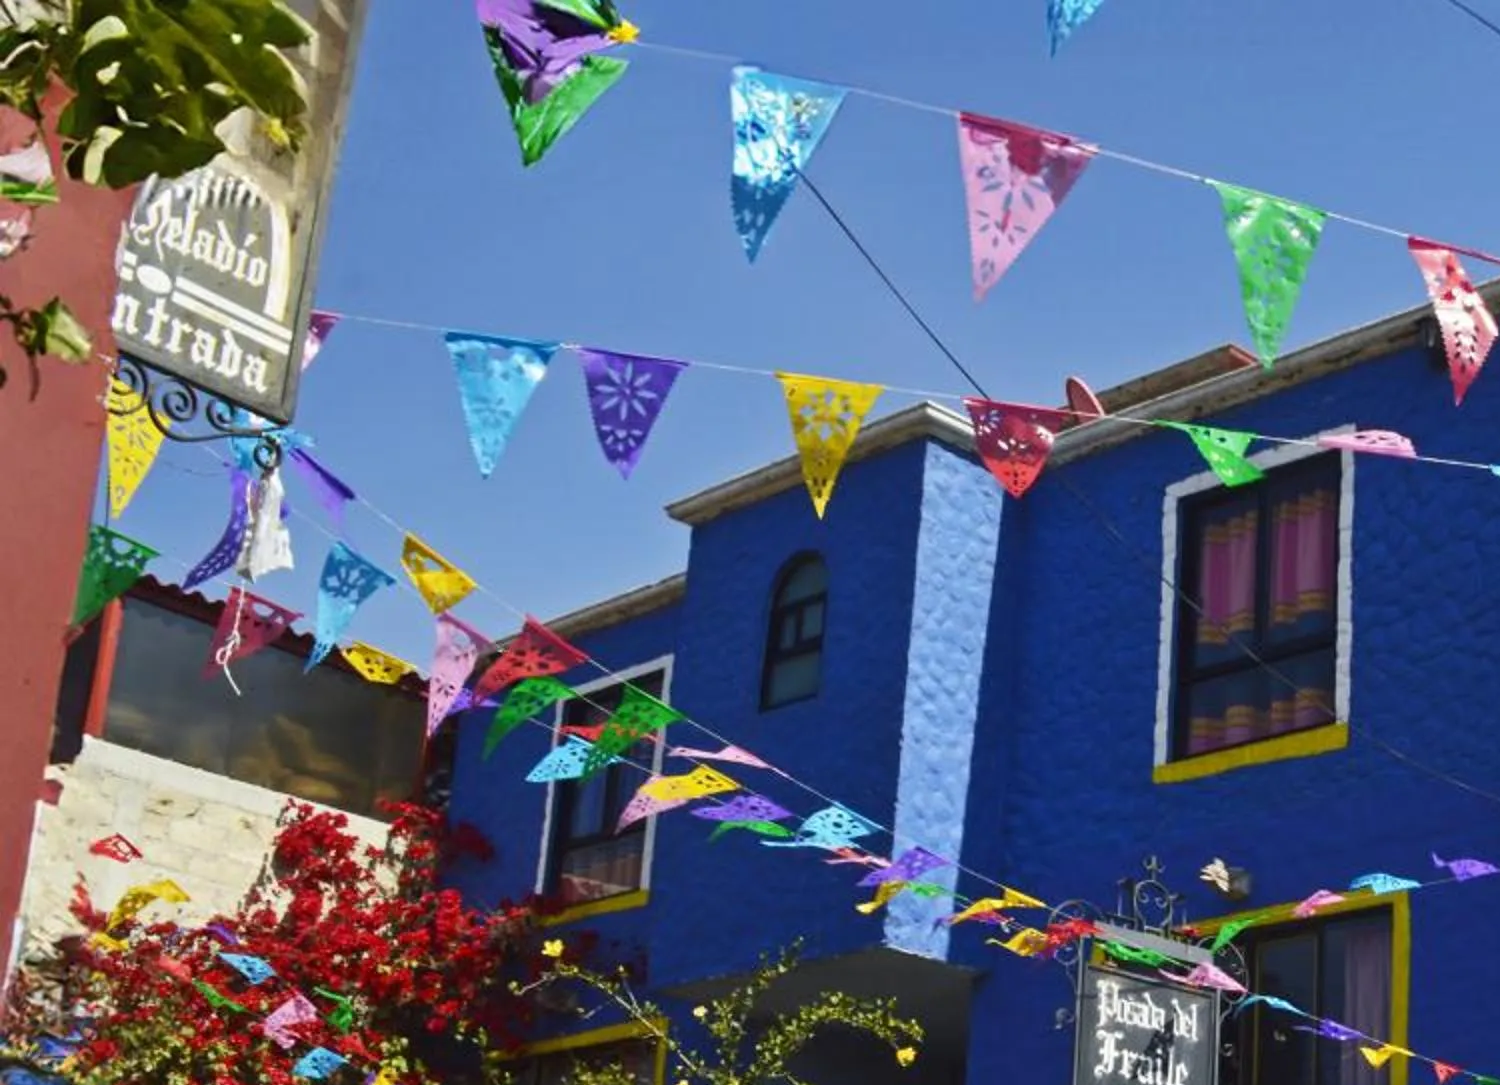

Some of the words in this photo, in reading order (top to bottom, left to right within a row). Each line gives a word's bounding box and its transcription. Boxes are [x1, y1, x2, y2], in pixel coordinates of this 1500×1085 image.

[111, 294, 268, 393] ntrada
[1096, 979, 1165, 1032] Posada
[1171, 998, 1199, 1042] del
